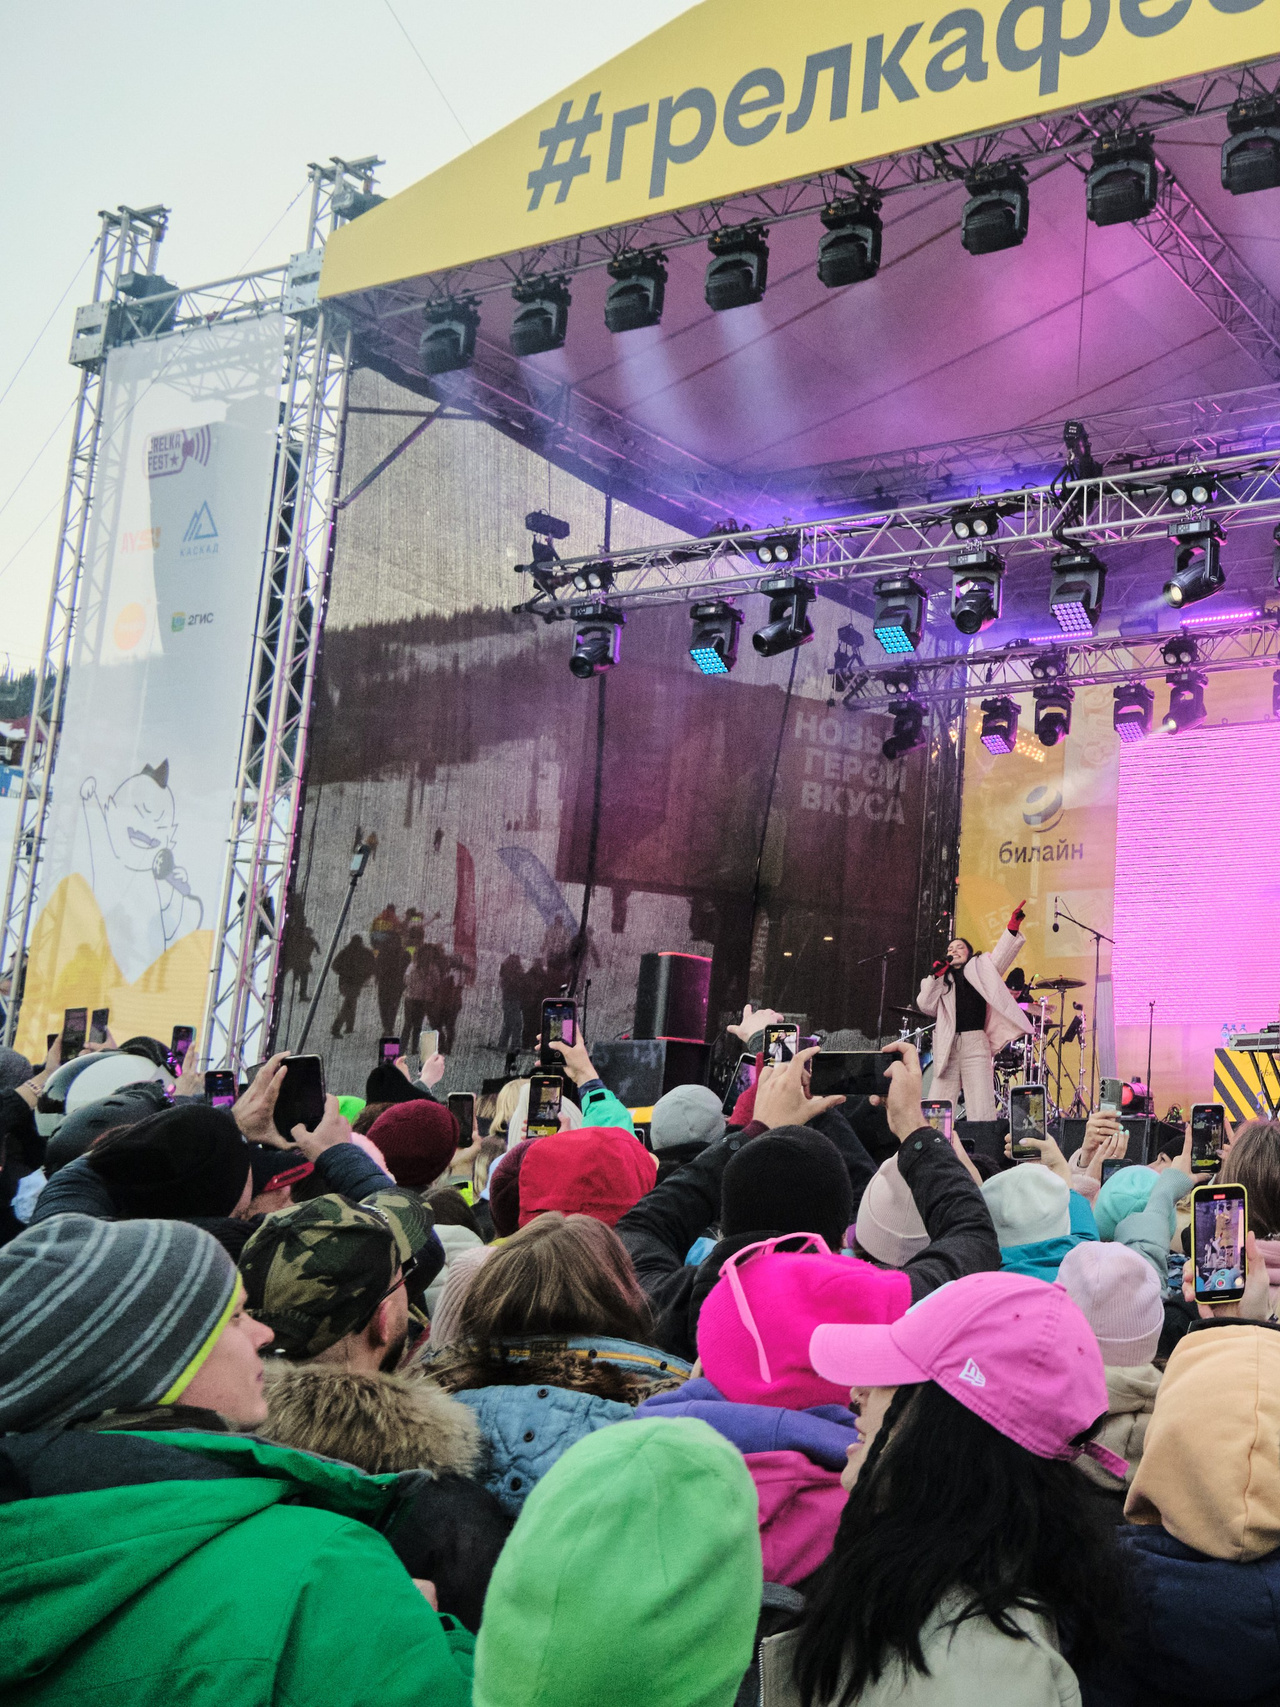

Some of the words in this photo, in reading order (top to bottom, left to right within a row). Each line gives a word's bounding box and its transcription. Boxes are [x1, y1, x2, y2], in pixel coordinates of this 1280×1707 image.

[187, 612, 215, 626] 2ГИС
[801, 780, 906, 825] ВКУСА
[999, 839, 1084, 865] билайн
